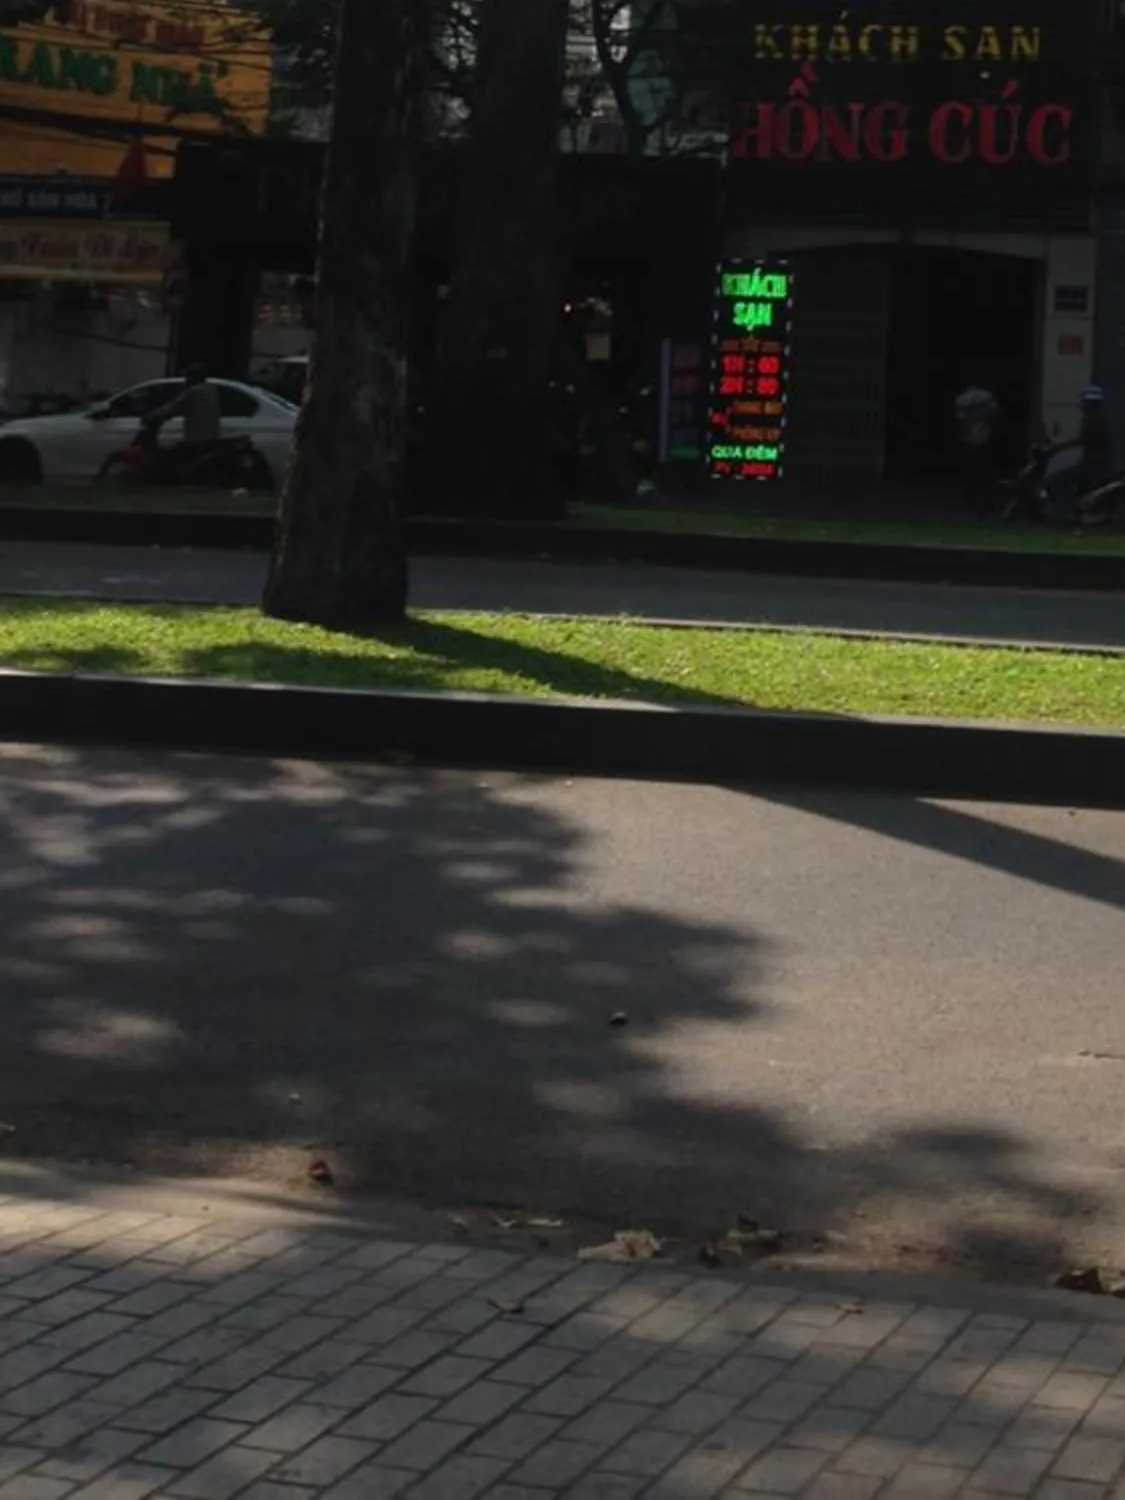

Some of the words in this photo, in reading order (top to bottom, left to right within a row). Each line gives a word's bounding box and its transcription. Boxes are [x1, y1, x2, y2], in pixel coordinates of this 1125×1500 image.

[754, 9, 920, 62] KHÁCH
[941, 25, 1041, 80] SẠN
[928, 78, 1074, 165] CÚC
[721, 267, 787, 298] KHÁCH
[732, 302, 773, 332] SẠN
[711, 444, 743, 460] QUA
